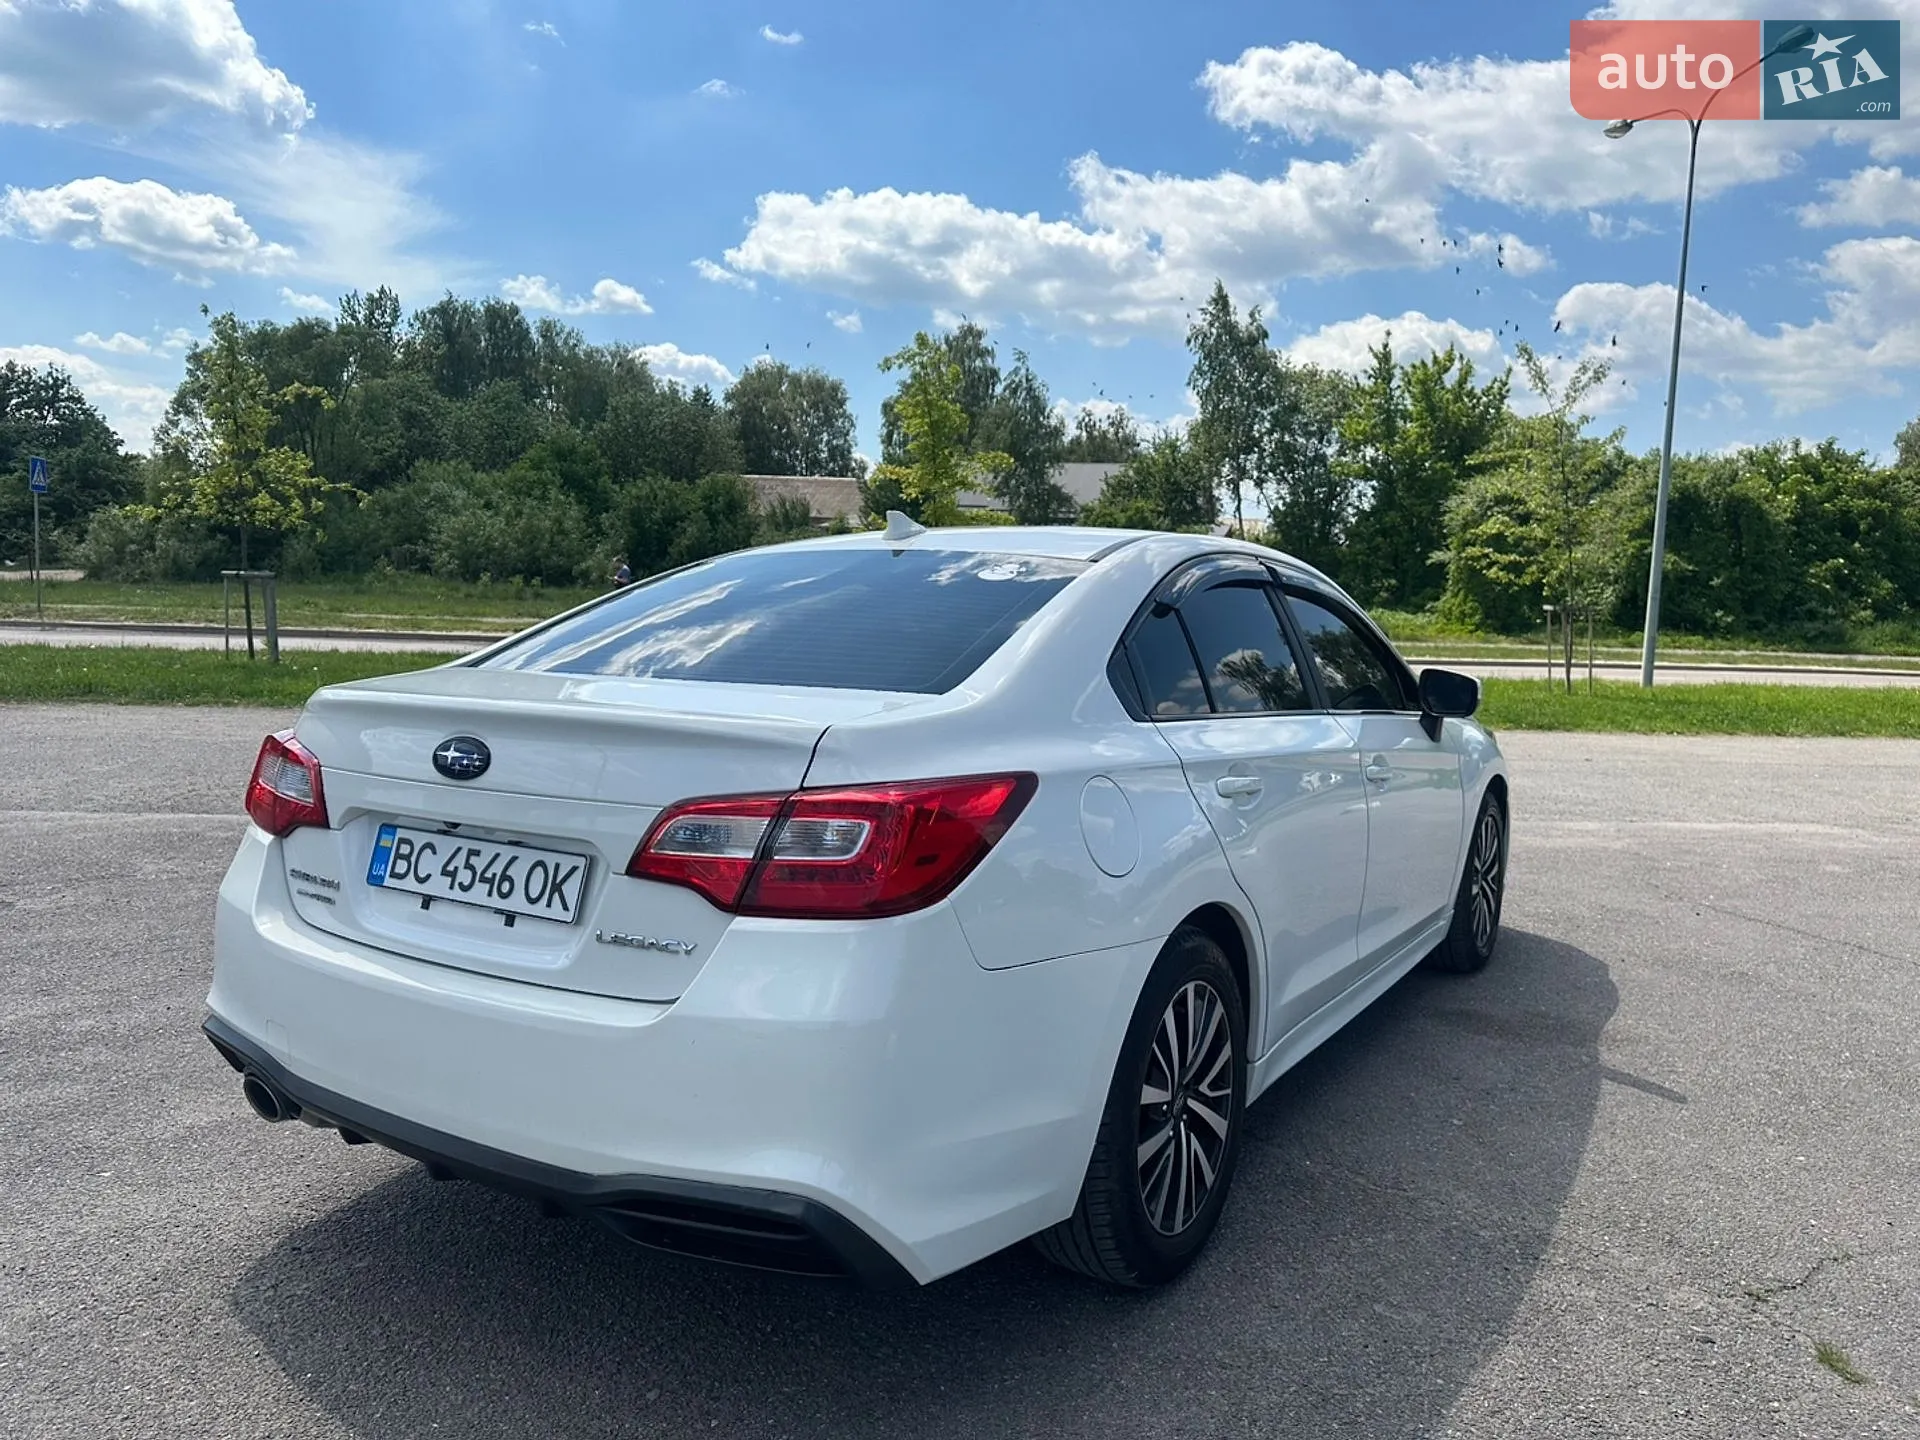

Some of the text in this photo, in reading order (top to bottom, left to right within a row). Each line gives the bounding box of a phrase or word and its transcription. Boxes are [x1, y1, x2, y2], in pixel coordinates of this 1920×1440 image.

[372, 861, 385, 877] UA
[389, 837, 437, 884] BC
[440, 846, 519, 900] 4546
[524, 859, 580, 912] OK
[596, 928, 698, 955] LEGACY
